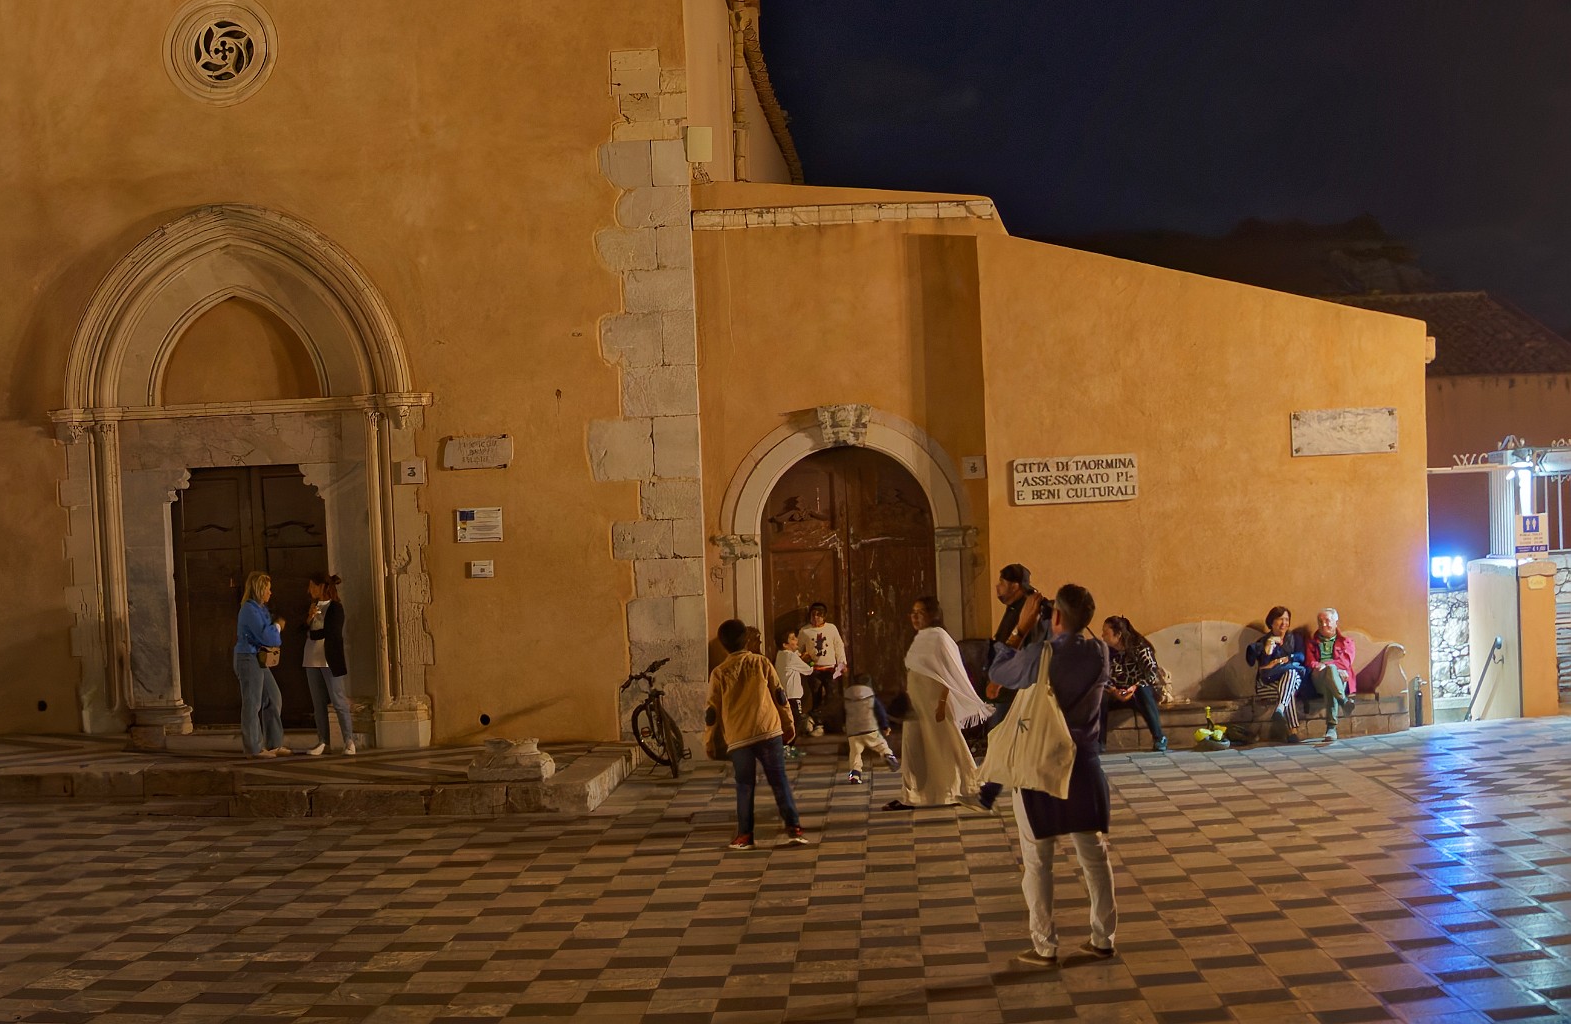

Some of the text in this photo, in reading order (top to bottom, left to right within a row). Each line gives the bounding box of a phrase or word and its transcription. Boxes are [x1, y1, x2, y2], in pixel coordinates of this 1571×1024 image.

[1056, 460, 1070, 472] DI
[1072, 457, 1136, 471] TAORMINA
[1017, 485, 1137, 501] E BENI CULTURALI
